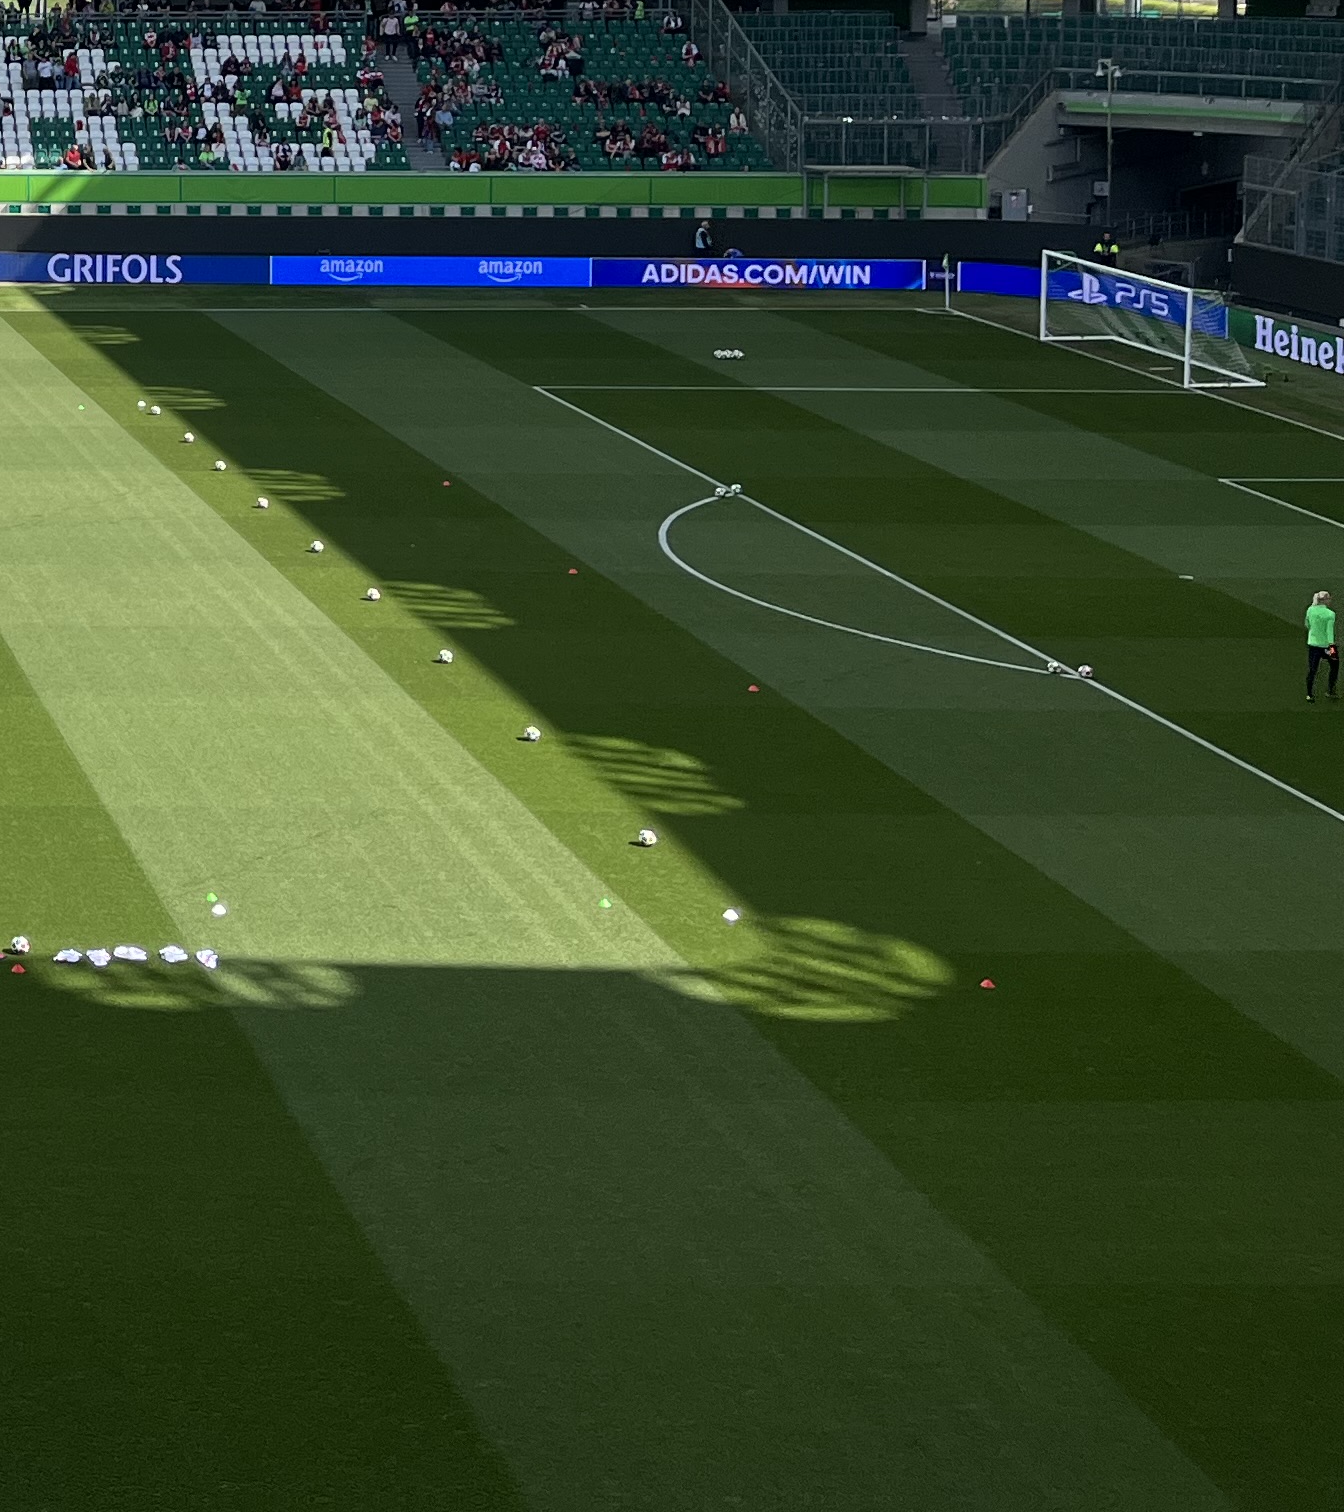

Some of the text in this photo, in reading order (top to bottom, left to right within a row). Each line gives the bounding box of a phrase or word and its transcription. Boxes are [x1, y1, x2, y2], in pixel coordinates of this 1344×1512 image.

[47, 253, 182, 284] GRIFOLS
[320, 259, 384, 273] amazon
[478, 260, 542, 275] amazon
[642, 263, 871, 286] ADIDAS.COM/WIN
[1115, 282, 1169, 317] PS5
